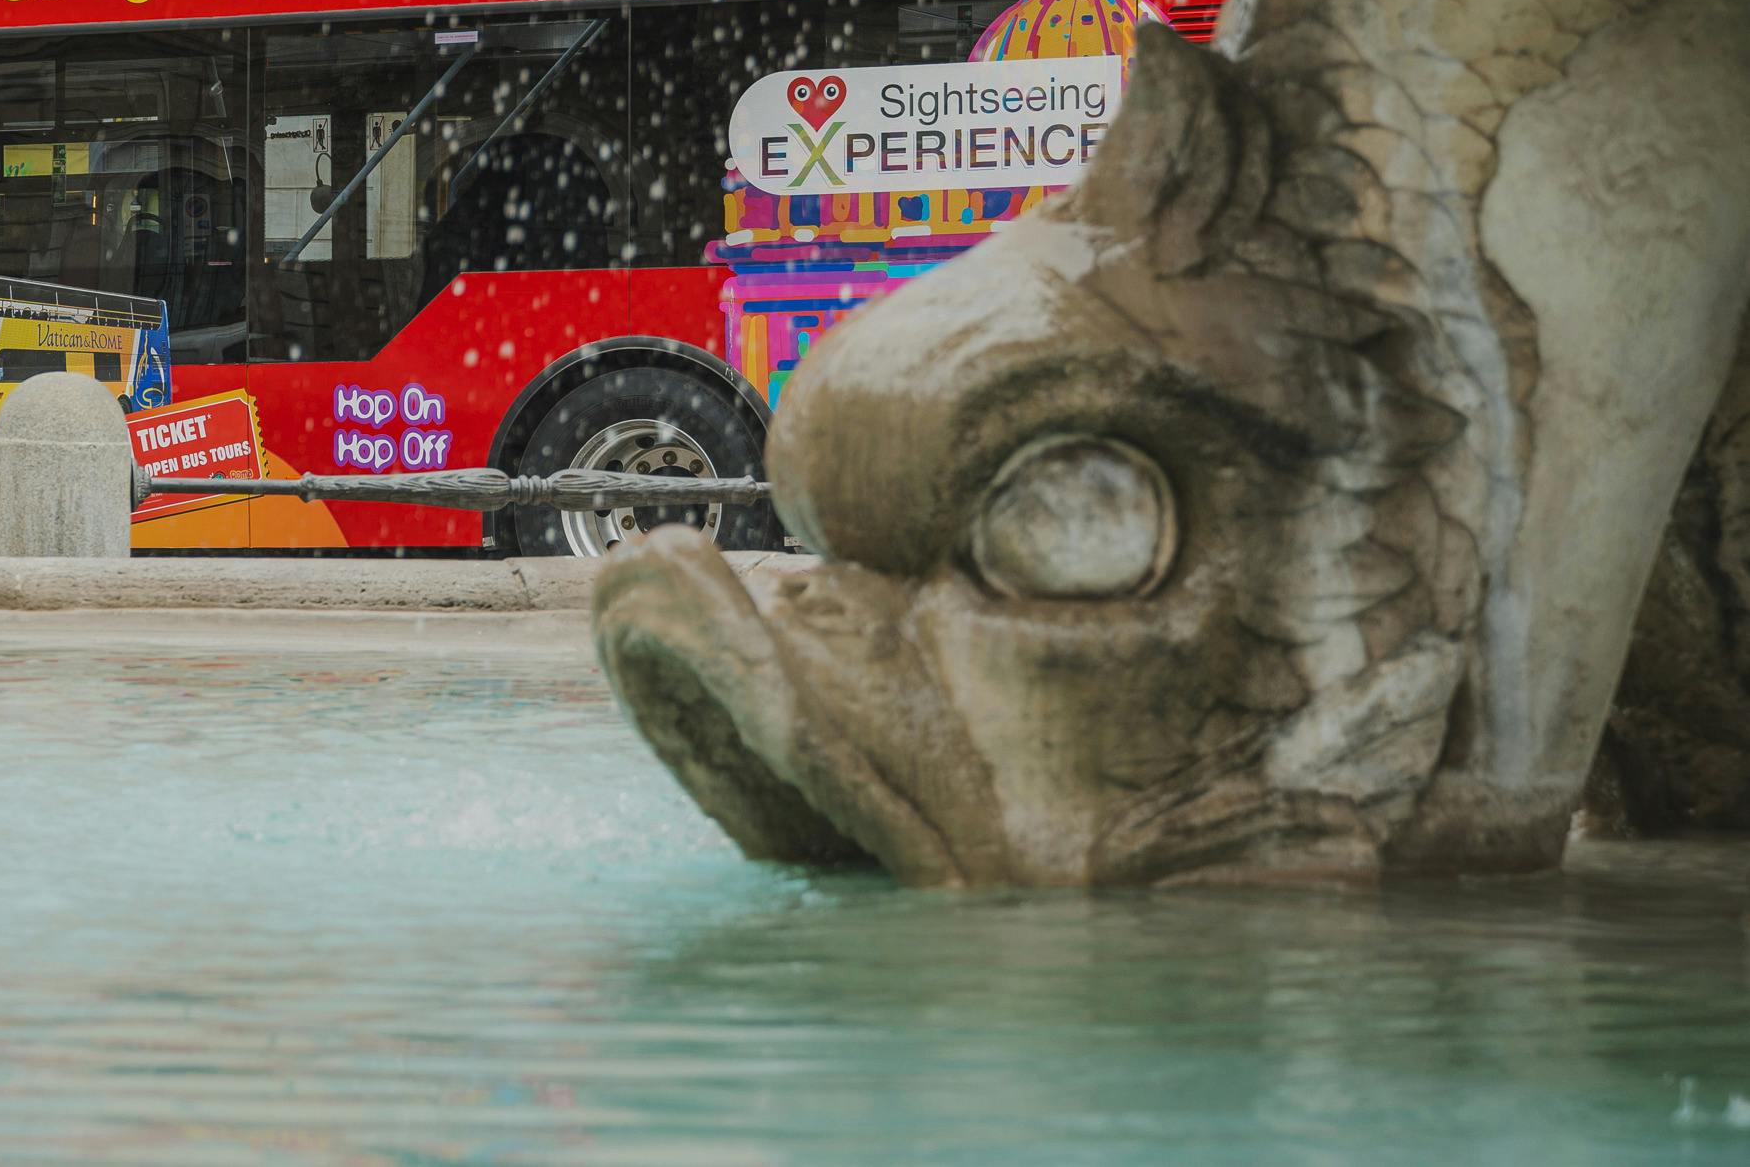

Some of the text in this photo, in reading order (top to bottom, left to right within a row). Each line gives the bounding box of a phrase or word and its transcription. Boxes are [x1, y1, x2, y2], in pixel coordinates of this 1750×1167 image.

[880, 77, 1106, 126] Sightseeing
[337, 387, 442, 425] Hop On
[144, 441, 251, 478] OPEN BUS TOURS
[337, 432, 449, 469] Hop Off
